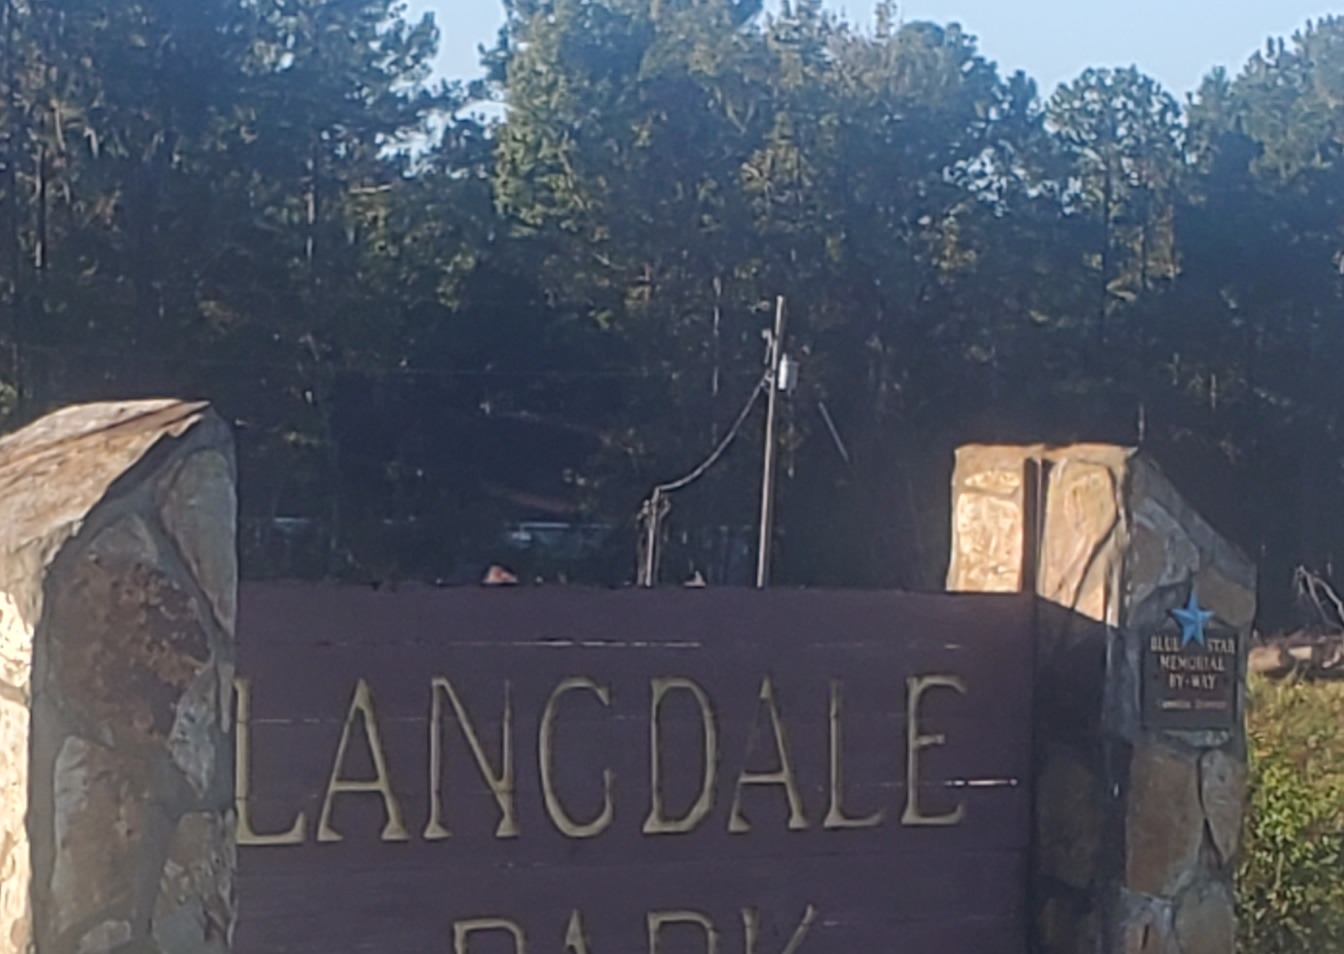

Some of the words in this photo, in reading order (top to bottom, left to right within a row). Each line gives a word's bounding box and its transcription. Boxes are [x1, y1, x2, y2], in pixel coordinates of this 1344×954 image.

[1150, 635, 1180, 652] BLUE
[1207, 637, 1236, 655] STAR
[1159, 654, 1226, 672] MEMORIAL
[233, 674, 968, 845] LANGDALE
